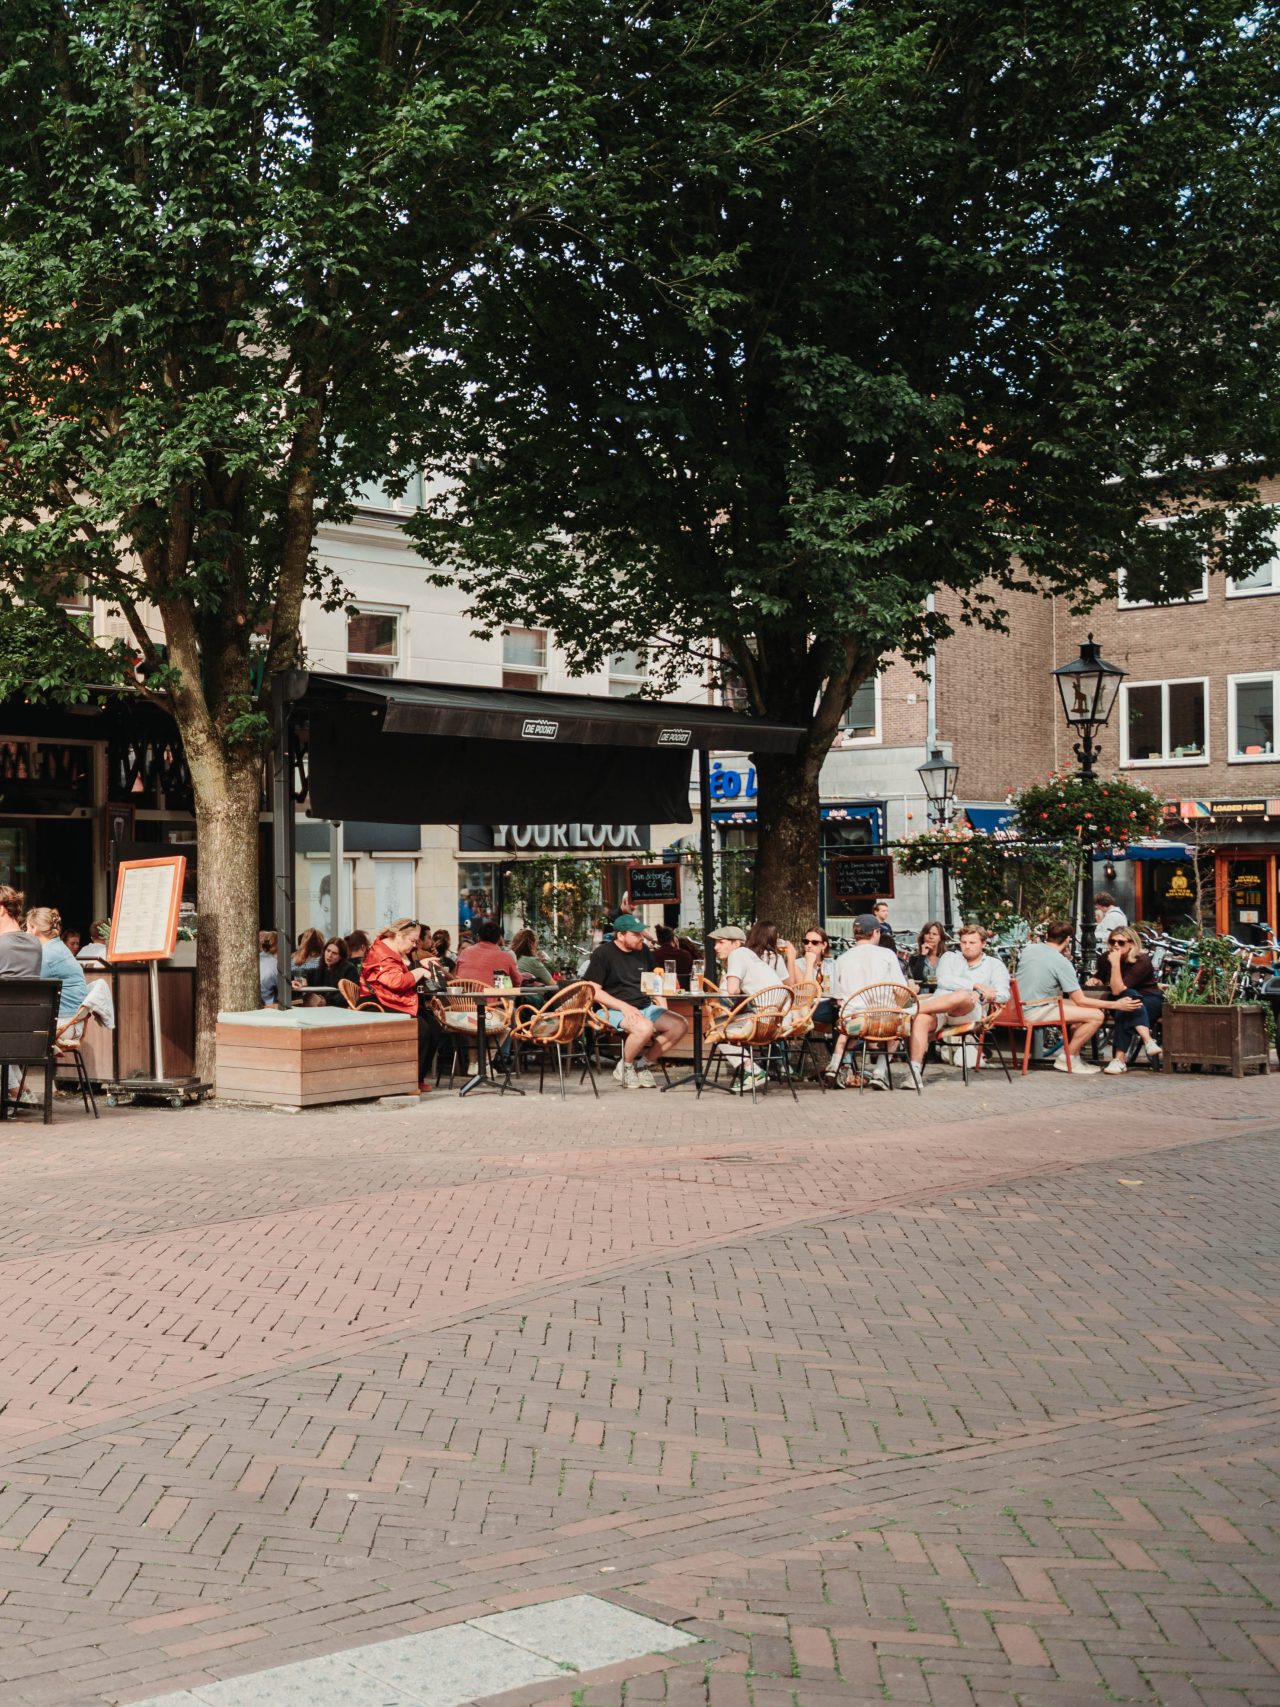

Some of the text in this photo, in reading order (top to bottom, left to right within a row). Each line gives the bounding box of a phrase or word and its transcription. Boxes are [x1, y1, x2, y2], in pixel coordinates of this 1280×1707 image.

[524, 724, 556, 735] DE POORT
[660, 733, 689, 742] DE POORT
[1212, 804, 1242, 812] LOADED
